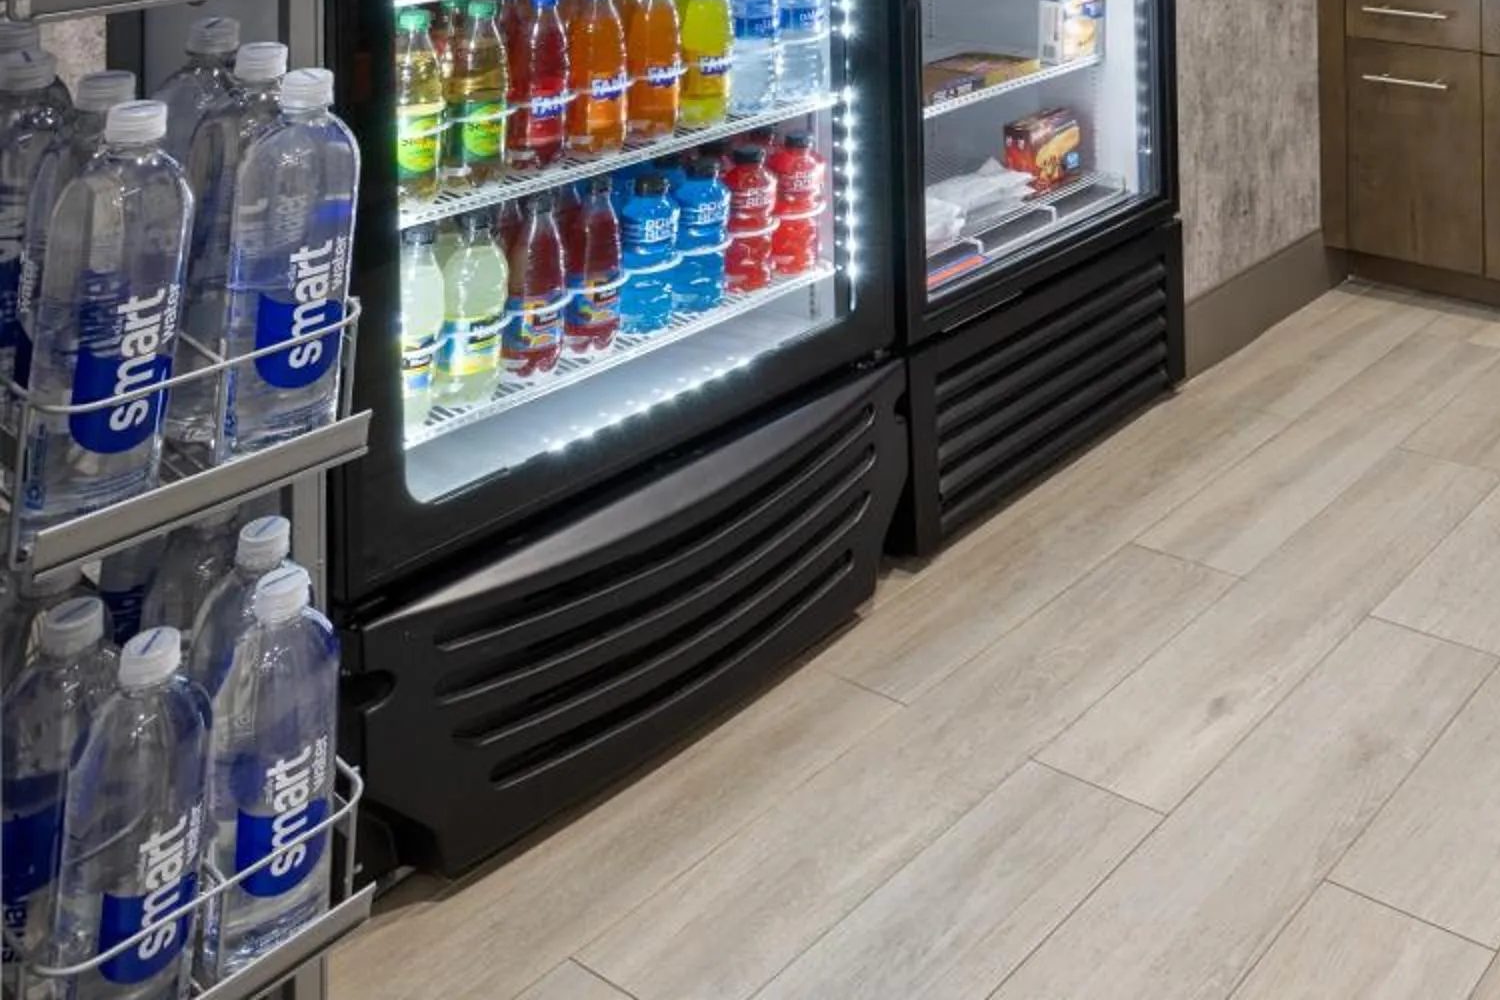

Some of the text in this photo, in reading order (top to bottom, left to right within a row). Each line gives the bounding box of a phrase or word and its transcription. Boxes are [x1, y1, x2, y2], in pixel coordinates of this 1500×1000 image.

[161, 282, 182, 347] water
[288, 239, 333, 370] smart
[331, 235, 348, 293] water
[110, 287, 167, 433] smart
[268, 744, 312, 878] smart
[138, 814, 190, 961] smart
